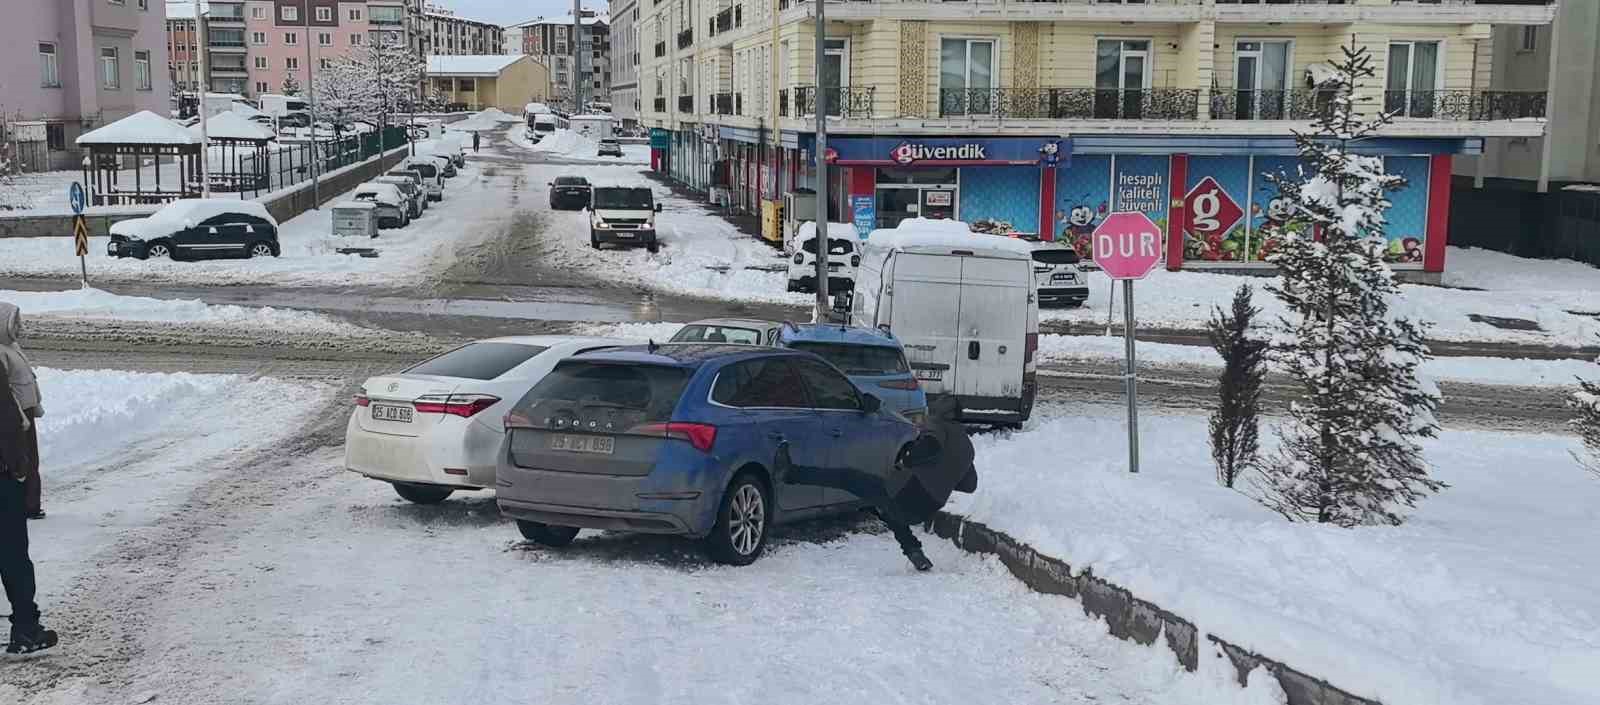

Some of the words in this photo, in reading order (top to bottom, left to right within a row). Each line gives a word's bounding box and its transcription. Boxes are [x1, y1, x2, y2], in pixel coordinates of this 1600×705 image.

[897, 143, 985, 164] güvendik
[1119, 171, 1162, 188] hesaplı
[1119, 186, 1160, 199] kaliteli
[1099, 232, 1155, 259] DUR
